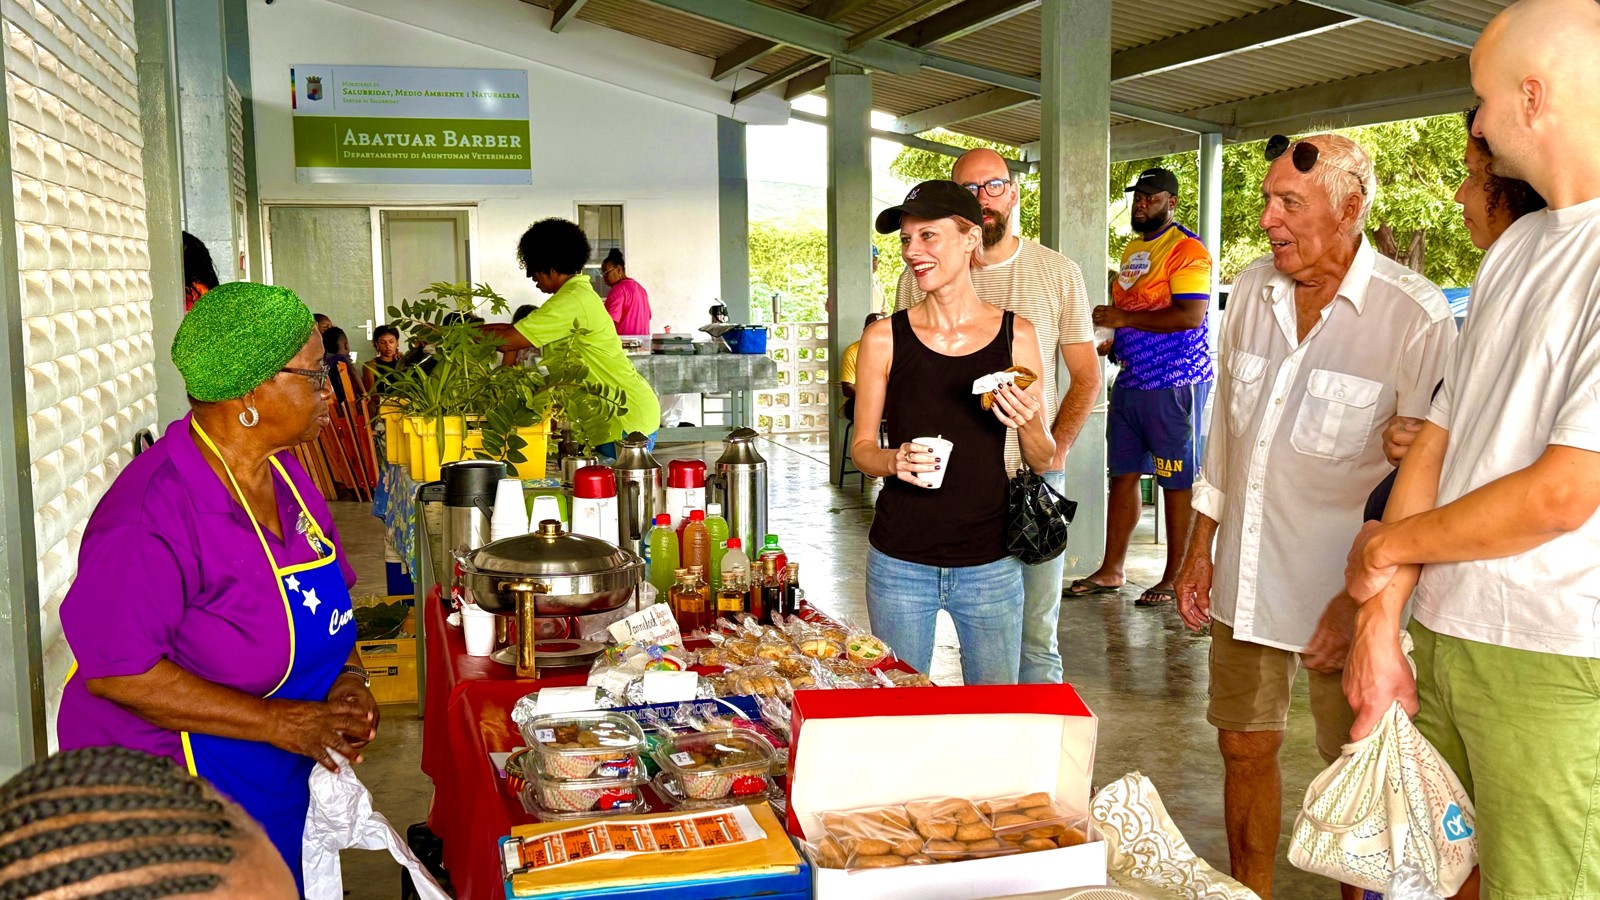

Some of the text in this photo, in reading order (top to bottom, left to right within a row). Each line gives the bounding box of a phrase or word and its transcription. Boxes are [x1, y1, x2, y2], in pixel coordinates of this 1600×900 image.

[342, 88, 393, 97] SALUBRIDAT,
[395, 89, 422, 97] MEDIO
[424, 90, 465, 98] AMBIENTE
[471, 90, 520, 99] NATURALESA
[343, 128, 522, 148] ABATUAR BARBER
[343, 150, 409, 160] DEPARTAMENTU
[421, 152, 470, 160] ASUNTUNAN
[471, 152, 523, 161] VETERINARIO
